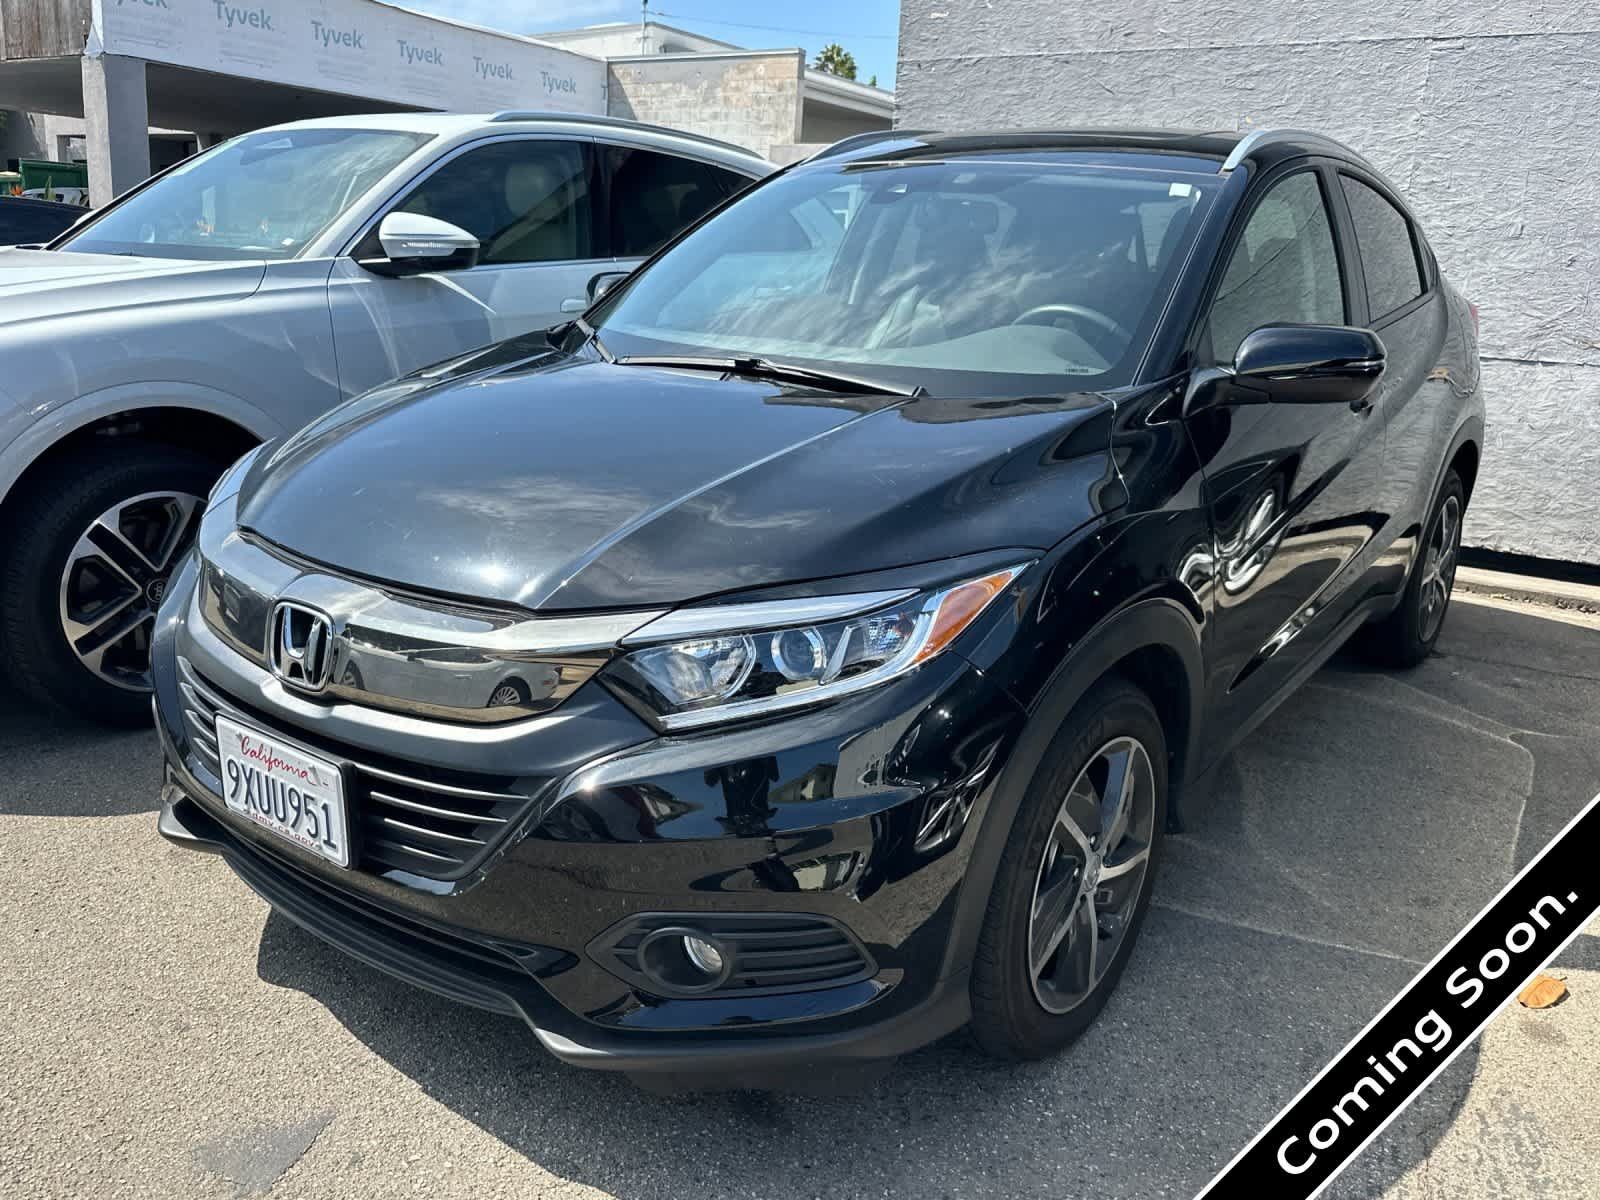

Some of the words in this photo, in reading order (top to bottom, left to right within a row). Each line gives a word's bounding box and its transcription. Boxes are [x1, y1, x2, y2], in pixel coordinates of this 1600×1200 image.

[213, 0, 273, 29] Tyvek
[311, 20, 364, 48] Tyvek
[397, 39, 444, 65] Tyvek
[473, 56, 513, 80] Tyvek
[541, 71, 577, 94] Tyvek
[241, 735, 309, 779] California
[227, 758, 338, 850] 9XUU951
